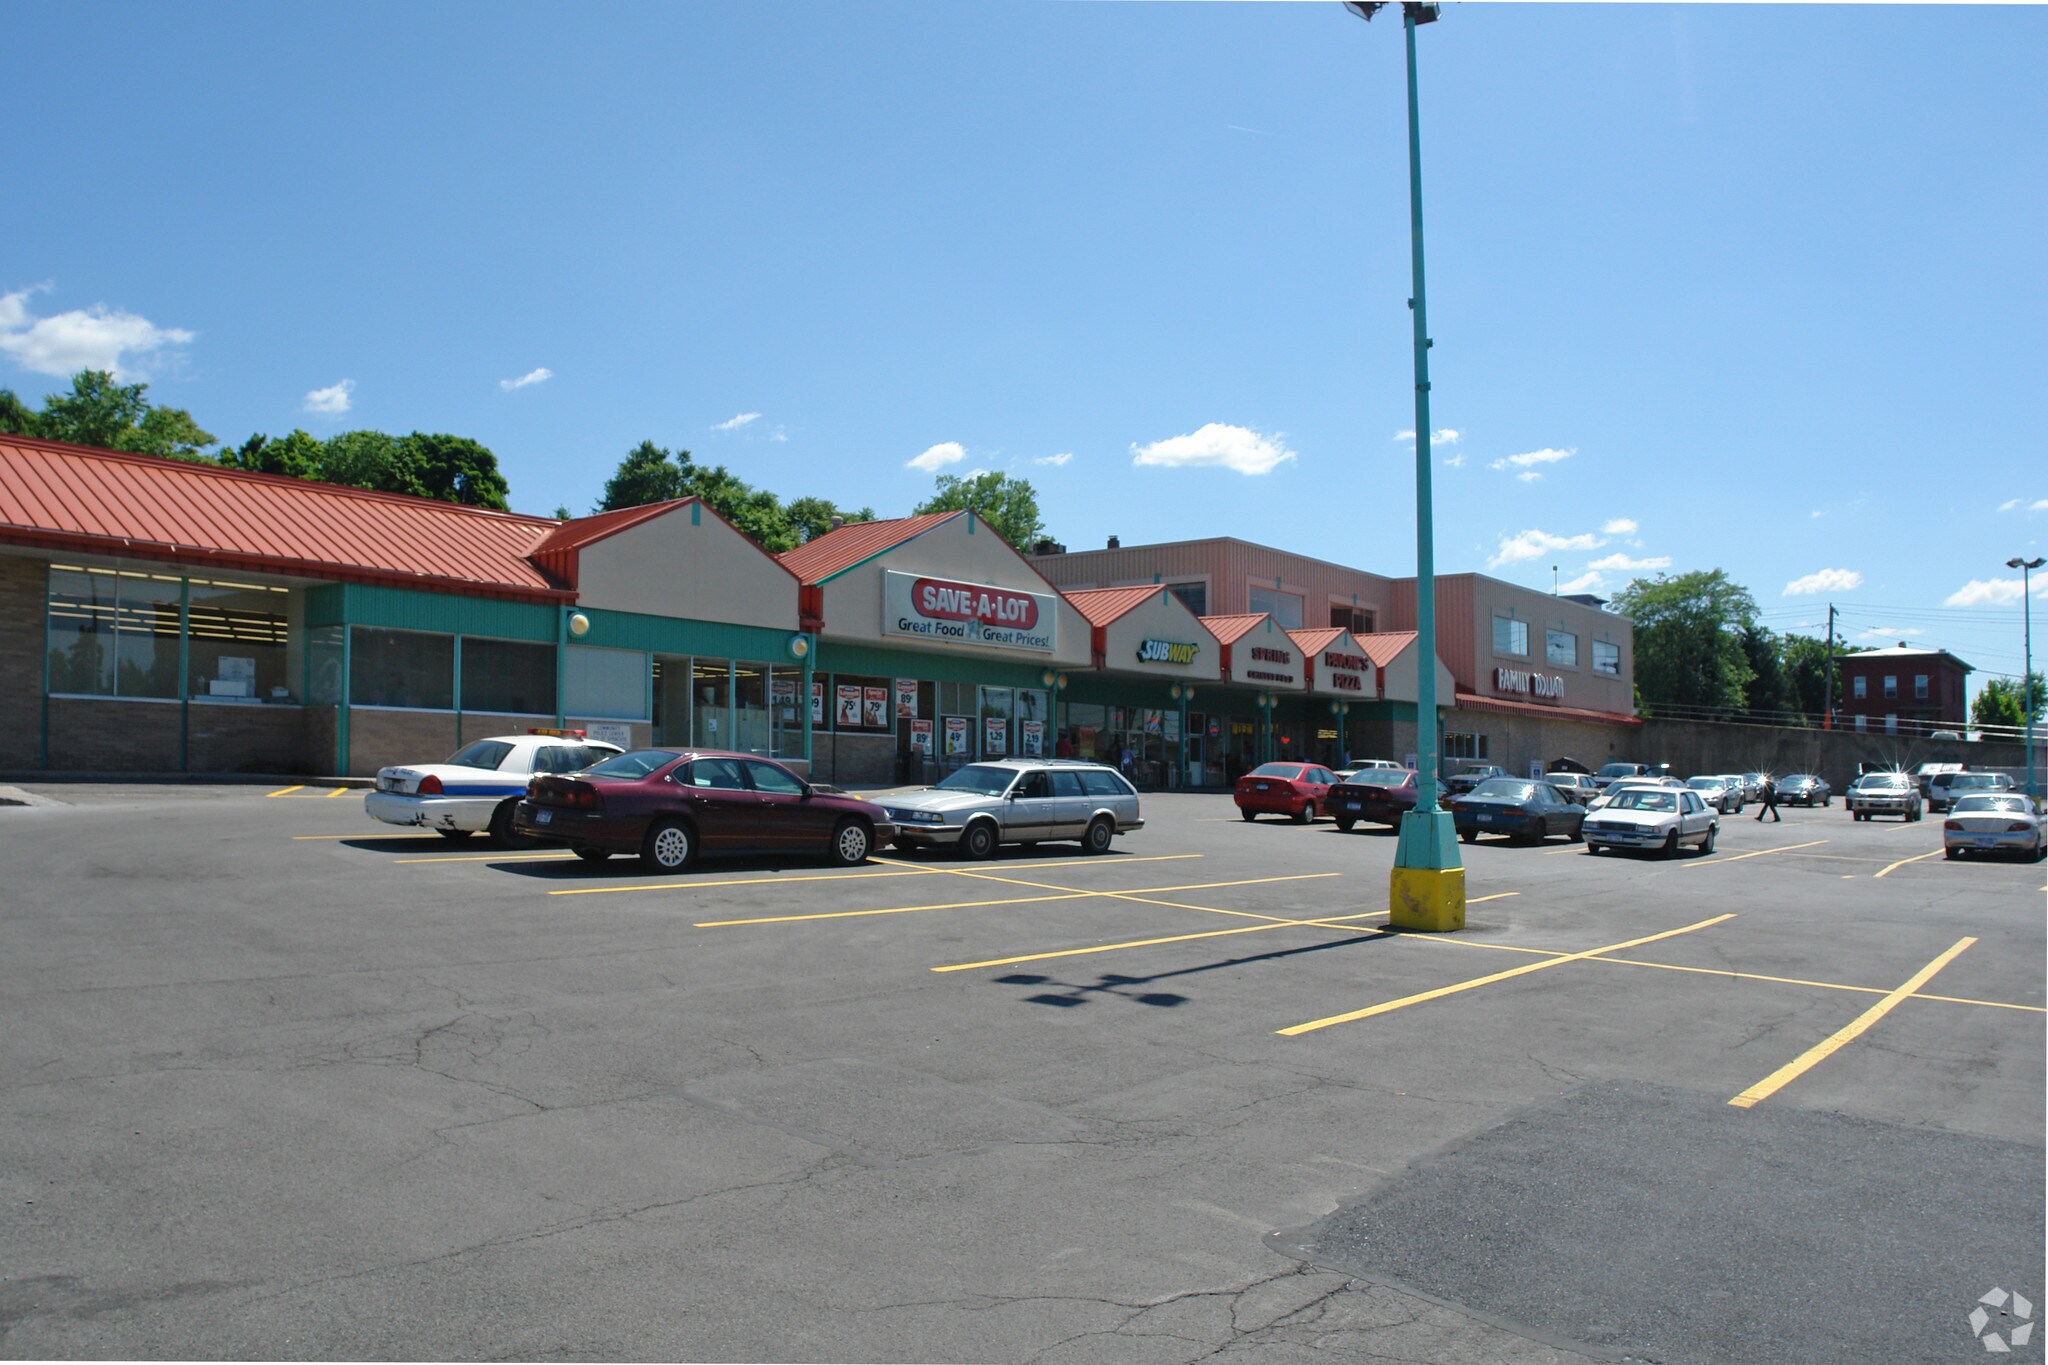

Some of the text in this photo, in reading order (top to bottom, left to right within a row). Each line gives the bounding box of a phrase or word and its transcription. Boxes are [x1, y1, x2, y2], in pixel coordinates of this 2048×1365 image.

[898, 618, 1049, 647] Great Food Great Prices!
[1136, 639, 1200, 664] SUBWAY
[1251, 647, 1290, 664] SPRING
[1333, 673, 1362, 690] PIZZA
[1494, 667, 1565, 698] FAMILY DOLLAR
